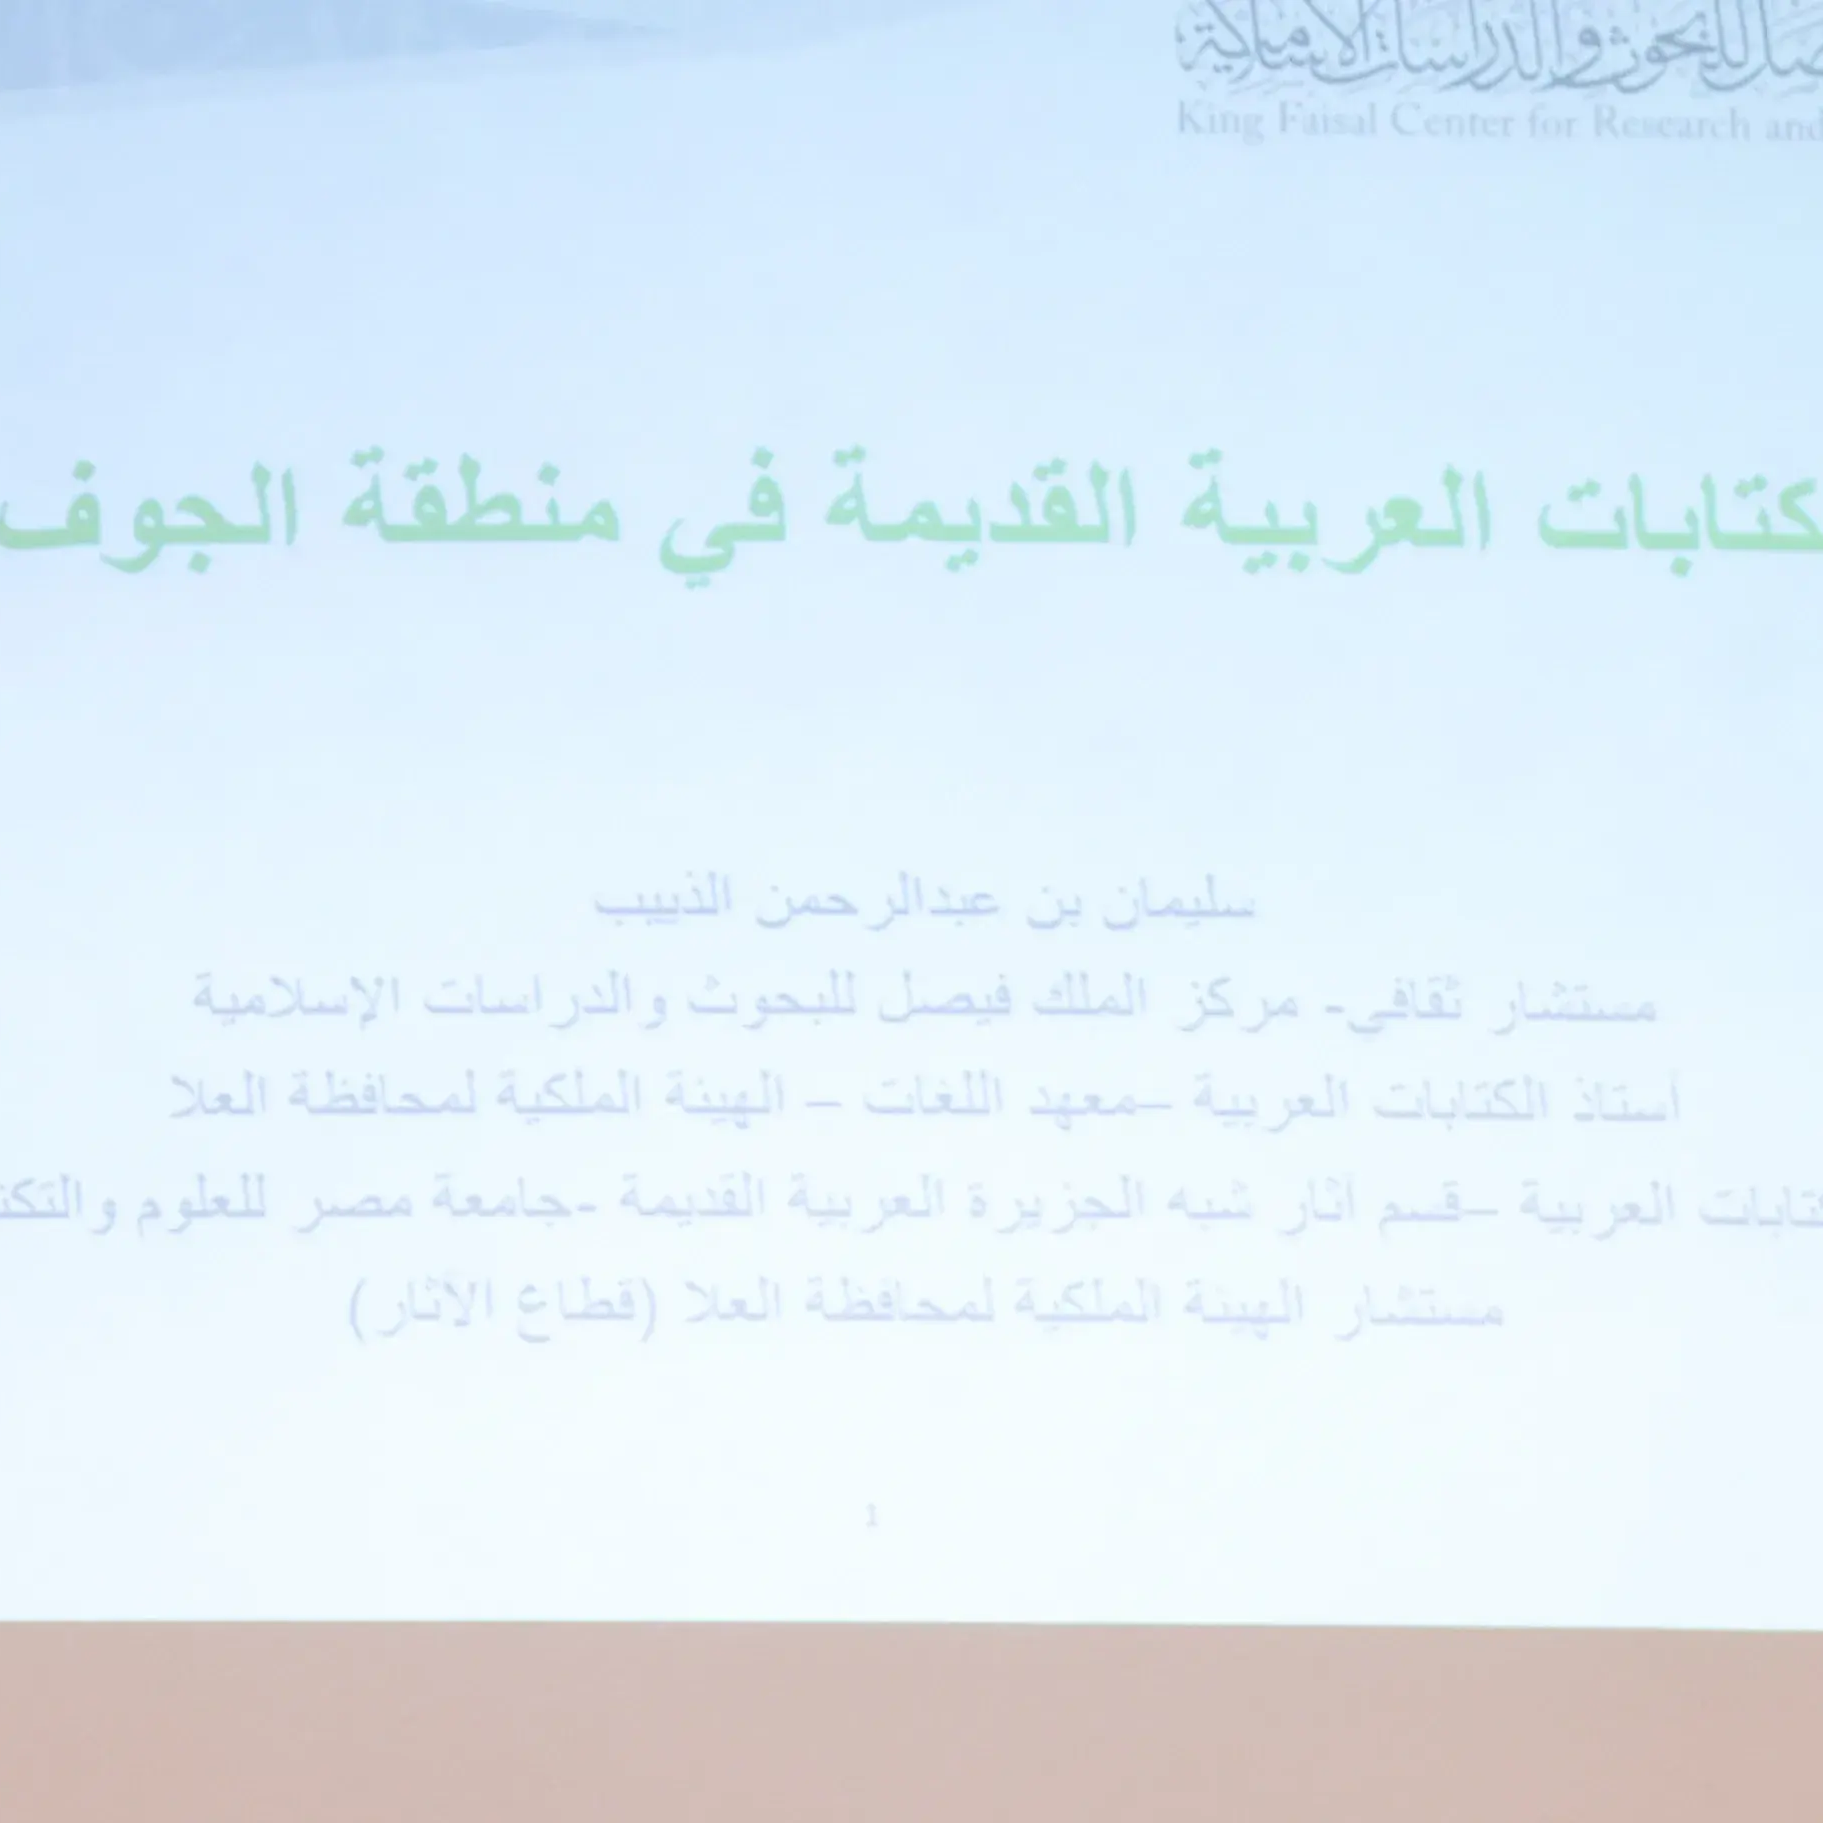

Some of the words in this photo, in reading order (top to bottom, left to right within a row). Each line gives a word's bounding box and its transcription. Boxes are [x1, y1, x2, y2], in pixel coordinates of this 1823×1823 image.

[1177, 97, 1266, 147] King
[1278, 97, 1377, 137] Faisal
[1389, 101, 1516, 140] Center
[1527, 101, 1580, 139] for
[1592, 102, 1751, 142] Research
[342, 445, 622, 544] منطقة
[658, 445, 789, 591] في
[824, 443, 1137, 573] القديمة
[1181, 446, 1493, 575] العربية
[755, 870, 1002, 935] عبدالرحمن
[1026, 886, 1084, 934] بن
[1102, 872, 1261, 933] سليمان
[422, 968, 669, 1034] والدراسات
[687, 968, 858, 1032] للبحوث
[877, 968, 1013, 1027] فيصل
[1032, 969, 1149, 1018] الملك
[1175, 973, 1300, 1036] مركز
[1487, 980, 1658, 1037] مستشار
[169, 1069, 268, 1119] العلا
[287, 1068, 479, 1117] لمحافظة
[495, 1067, 642, 1126] الملكية
[863, 1068, 1004, 1118] اللغات
[1192, 1069, 1350, 1135] العربية
[1372, 1074, 1549, 1133] الكتابات
[136, 1171, 267, 1238] للعلوم
[292, 1194, 414, 1238] مصر
[619, 1169, 766, 1230] القديمة
[787, 1172, 945, 1235] العربية
[968, 1174, 1149, 1236] الجزيرة
[1167, 1180, 1255, 1231] شبه
[1519, 1178, 1677, 1242] العربية
[683, 1275, 785, 1324] العلا
[804, 1274, 996, 1324] لمحافظة
[1013, 1276, 1164, 1335] الملكية
[1334, 1284, 1504, 1342] مستشار
